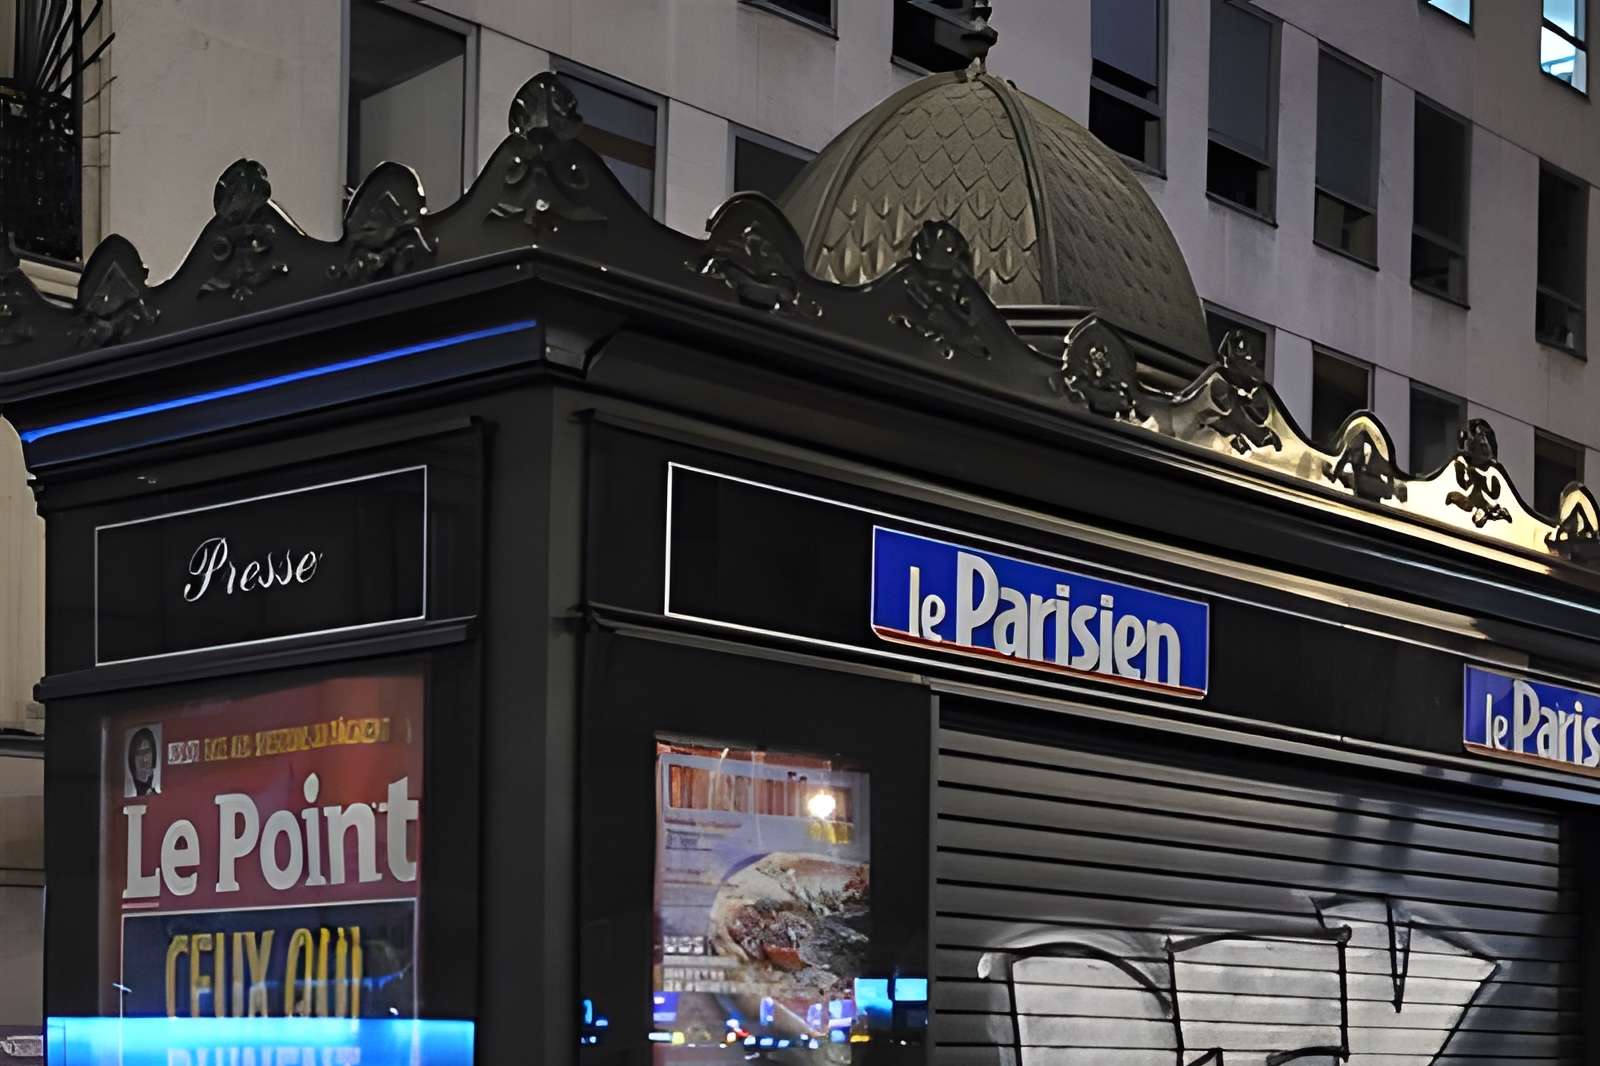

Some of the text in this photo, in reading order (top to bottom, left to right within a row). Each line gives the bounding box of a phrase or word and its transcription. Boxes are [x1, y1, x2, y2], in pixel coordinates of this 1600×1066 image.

[184, 537, 323, 602] Presse
[908, 551, 1181, 688] le Parisien
[1485, 693, 1508, 752] le
[122, 772, 419, 898] Le Point
